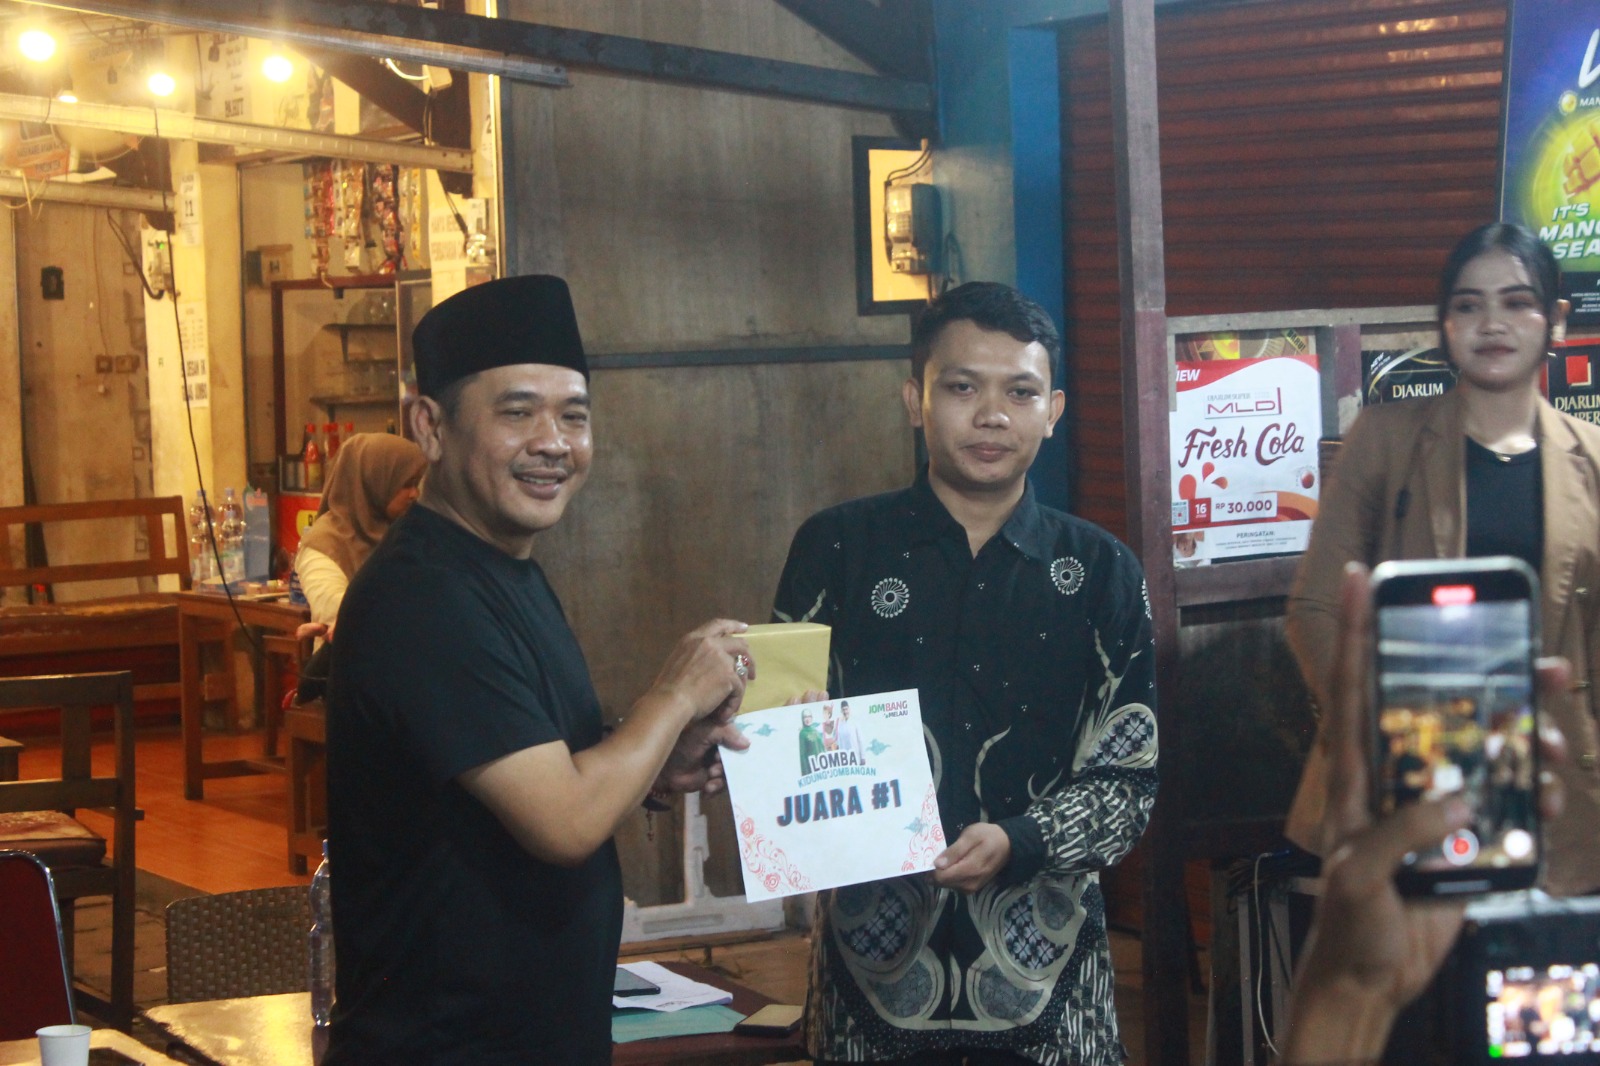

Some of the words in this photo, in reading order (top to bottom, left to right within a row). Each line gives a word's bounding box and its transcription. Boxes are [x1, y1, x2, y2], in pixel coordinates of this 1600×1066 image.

[1552, 203, 1590, 221] IT'S
[1392, 382, 1443, 399] DJARUM
[1178, 426, 1247, 468] Fresh
[1255, 422, 1304, 466] Cola
[1195, 503, 1207, 514] 16
[1227, 500, 1272, 514] 30.000
[869, 701, 908, 714] JOMBANG
[811, 751, 857, 772] LOMBA
[776, 785, 863, 827] JUARA
[871, 779, 902, 810] #1
